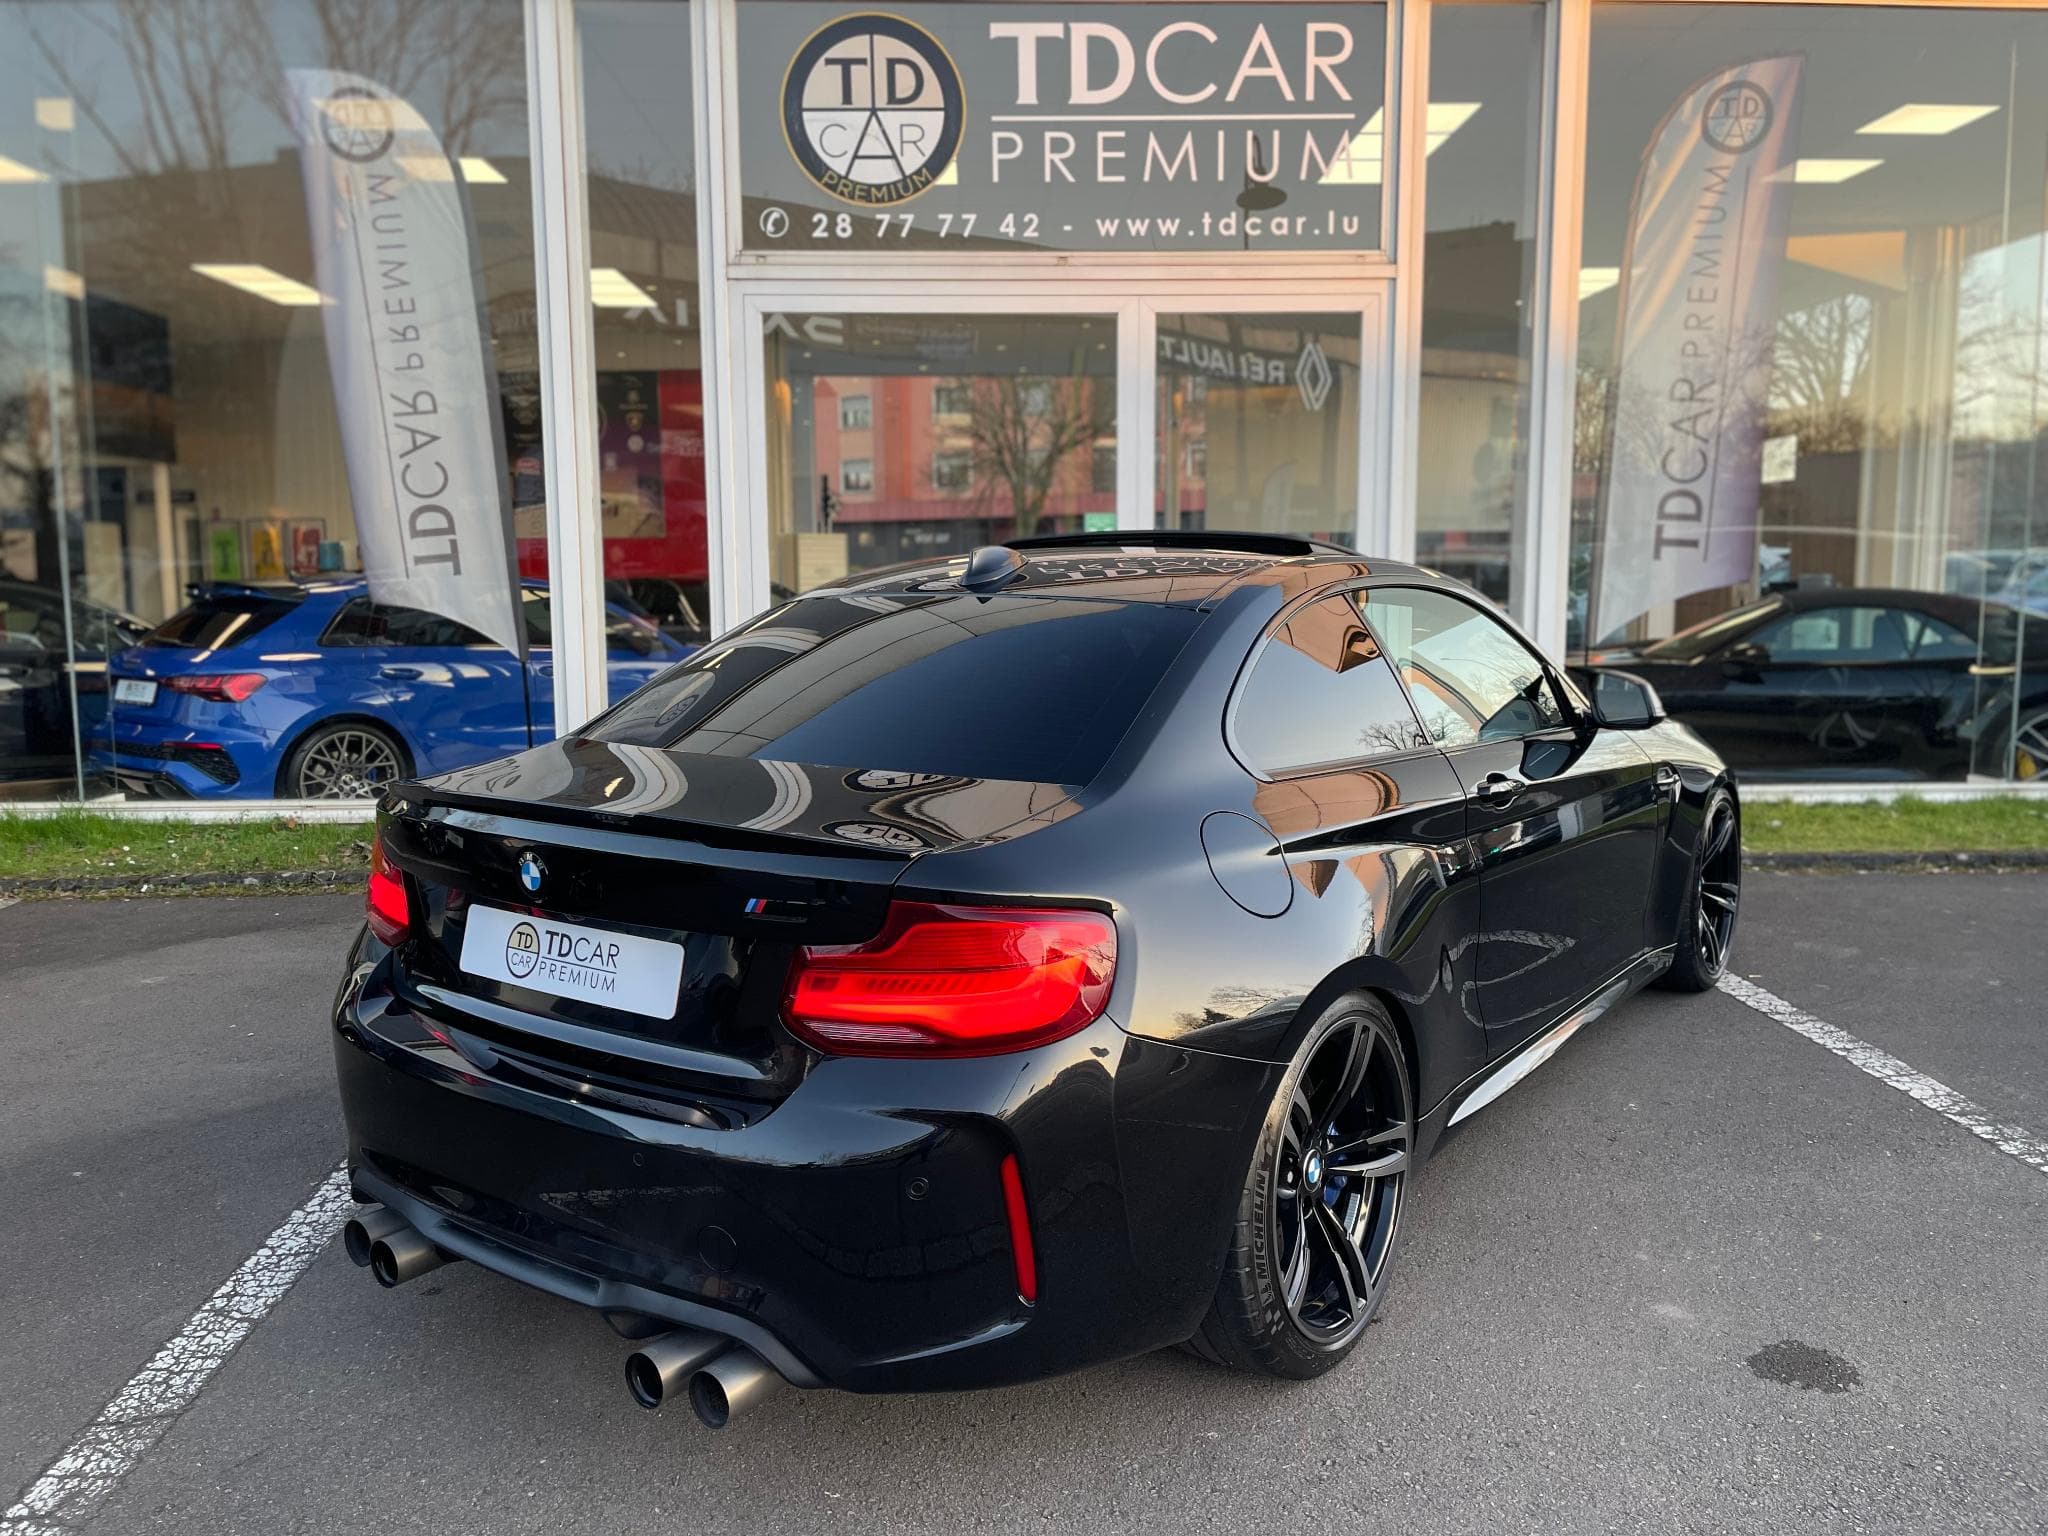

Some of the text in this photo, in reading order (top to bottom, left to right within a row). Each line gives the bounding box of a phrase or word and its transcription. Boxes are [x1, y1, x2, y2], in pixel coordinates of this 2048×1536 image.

[824, 57, 924, 106] TD
[990, 22, 1353, 104] TDCAR
[820, 110, 926, 177] CAR
[991, 129, 1353, 183] PREMIUM
[820, 167, 933, 203] PREMIUM
[812, 213, 852, 238] 28
[875, 214, 914, 238] 77
[938, 214, 977, 238] 77
[999, 213, 1039, 238] 42
[1096, 210, 1359, 237] www.tdcar.lu
[1653, 165, 1731, 561] TDCAR PREMIUM
[511, 953, 532, 968] CAR
[517, 931, 533, 949] TD
[545, 930, 620, 969] TDCAR
[538, 961, 615, 992] PREMIUM
[1253, 1171, 1269, 1280] MICHELIN
